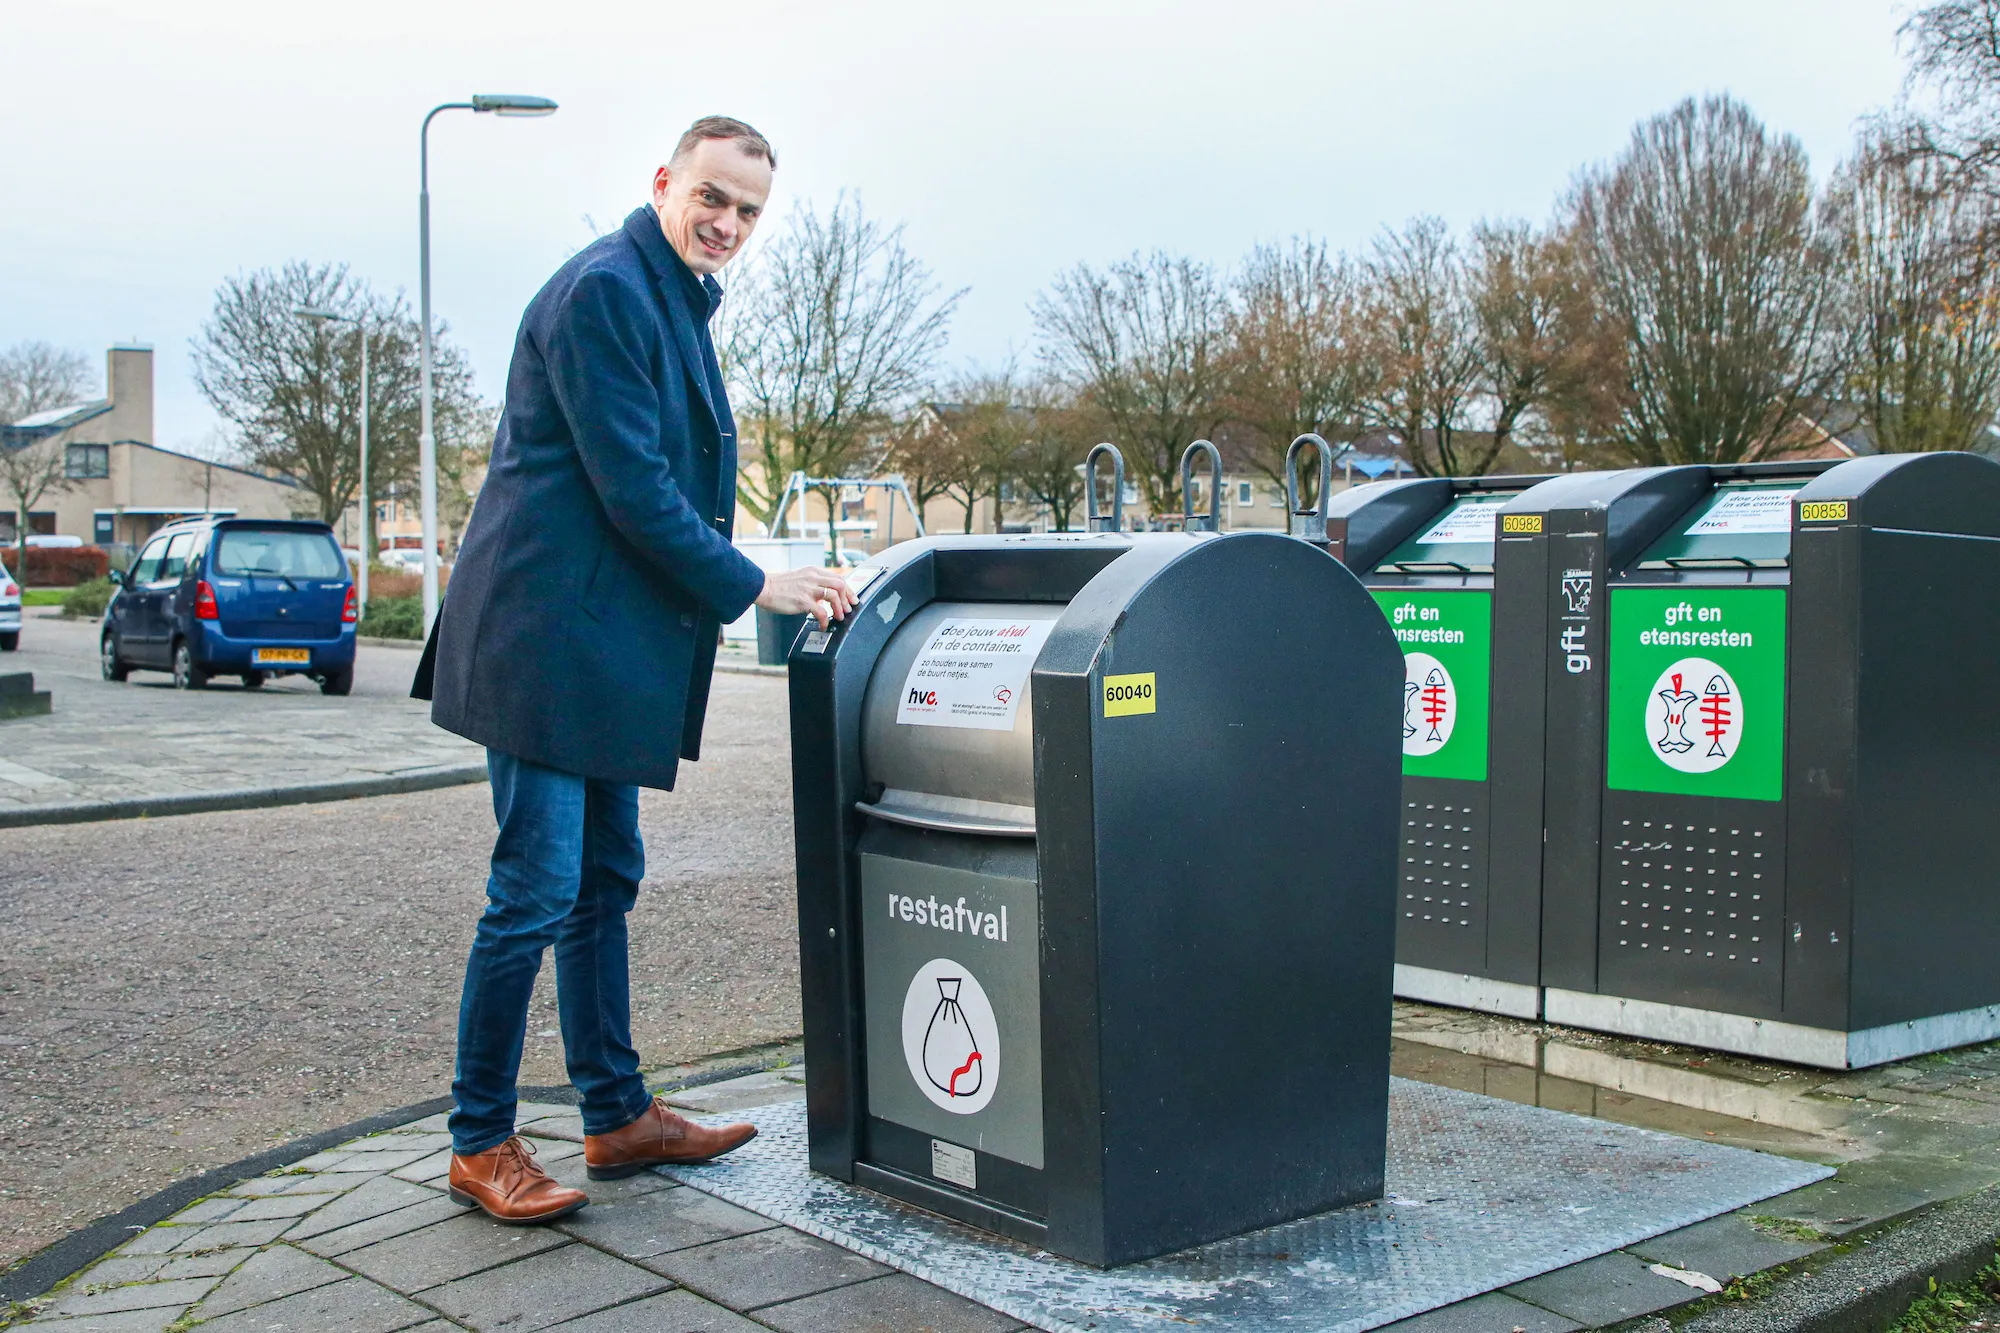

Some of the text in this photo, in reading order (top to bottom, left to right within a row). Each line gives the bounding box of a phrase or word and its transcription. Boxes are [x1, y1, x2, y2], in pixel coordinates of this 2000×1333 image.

[1802, 504, 1847, 519] 60853
[1504, 518, 1541, 531] 60982
[1394, 602, 1439, 624] gft en
[1665, 602, 1721, 626] gft en
[942, 625, 1030, 639] doe jouw afval
[1392, 627, 1464, 643] nsresten
[1640, 628, 1752, 646] etensresten
[931, 638, 1021, 652] in de container.
[1561, 625, 1591, 673] gft
[931, 659, 957, 668] houden
[927, 670, 946, 678] buurt
[947, 671, 969, 680] netjes.
[908, 688, 938, 706] hvc.
[1106, 684, 1151, 701] 60040
[888, 893, 1008, 942] restafval
